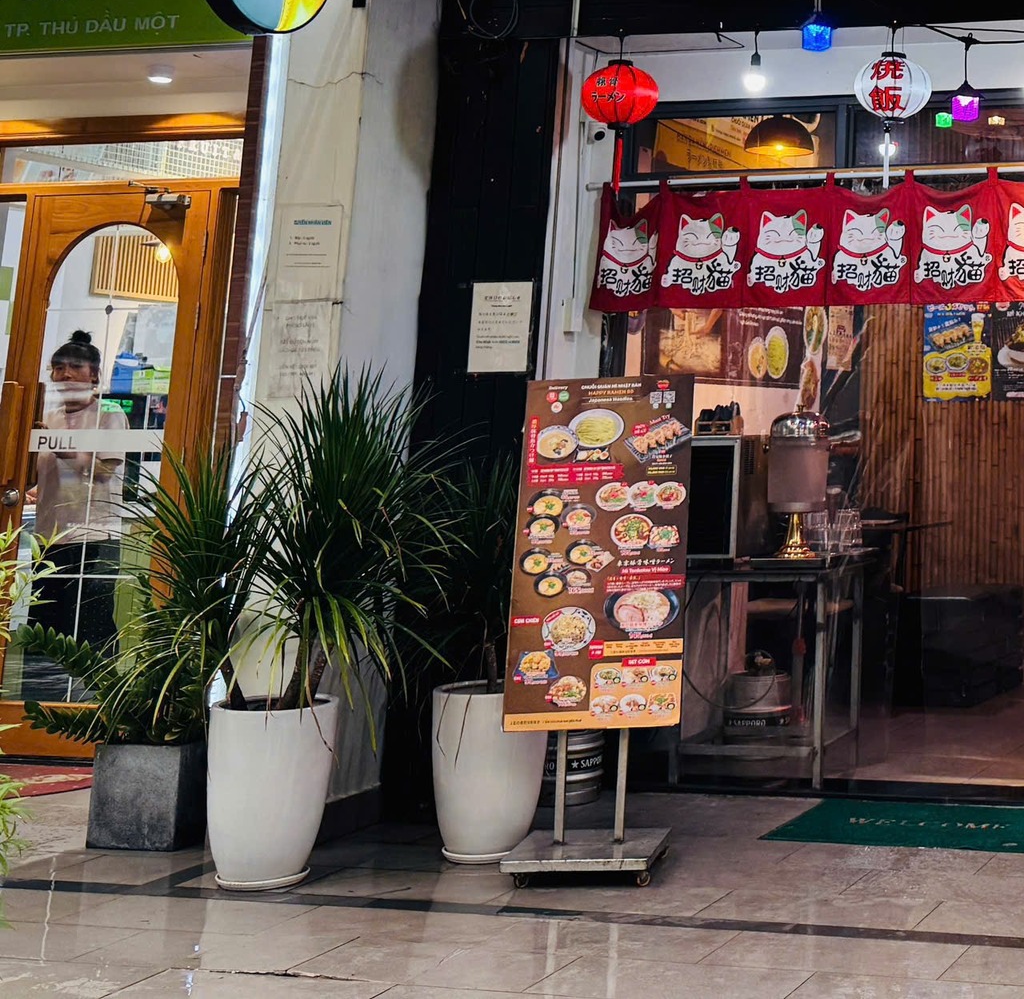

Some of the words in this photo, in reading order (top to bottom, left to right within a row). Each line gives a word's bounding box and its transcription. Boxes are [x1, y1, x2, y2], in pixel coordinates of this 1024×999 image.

[5, 23, 30, 37] TP.
[40, 16, 78, 36] THỦ
[85, 9, 126, 33] DẦU
[135, 11, 180, 35] MỘT
[591, 89, 626, 103] ラーメン
[37, 436, 77, 450] PULL
